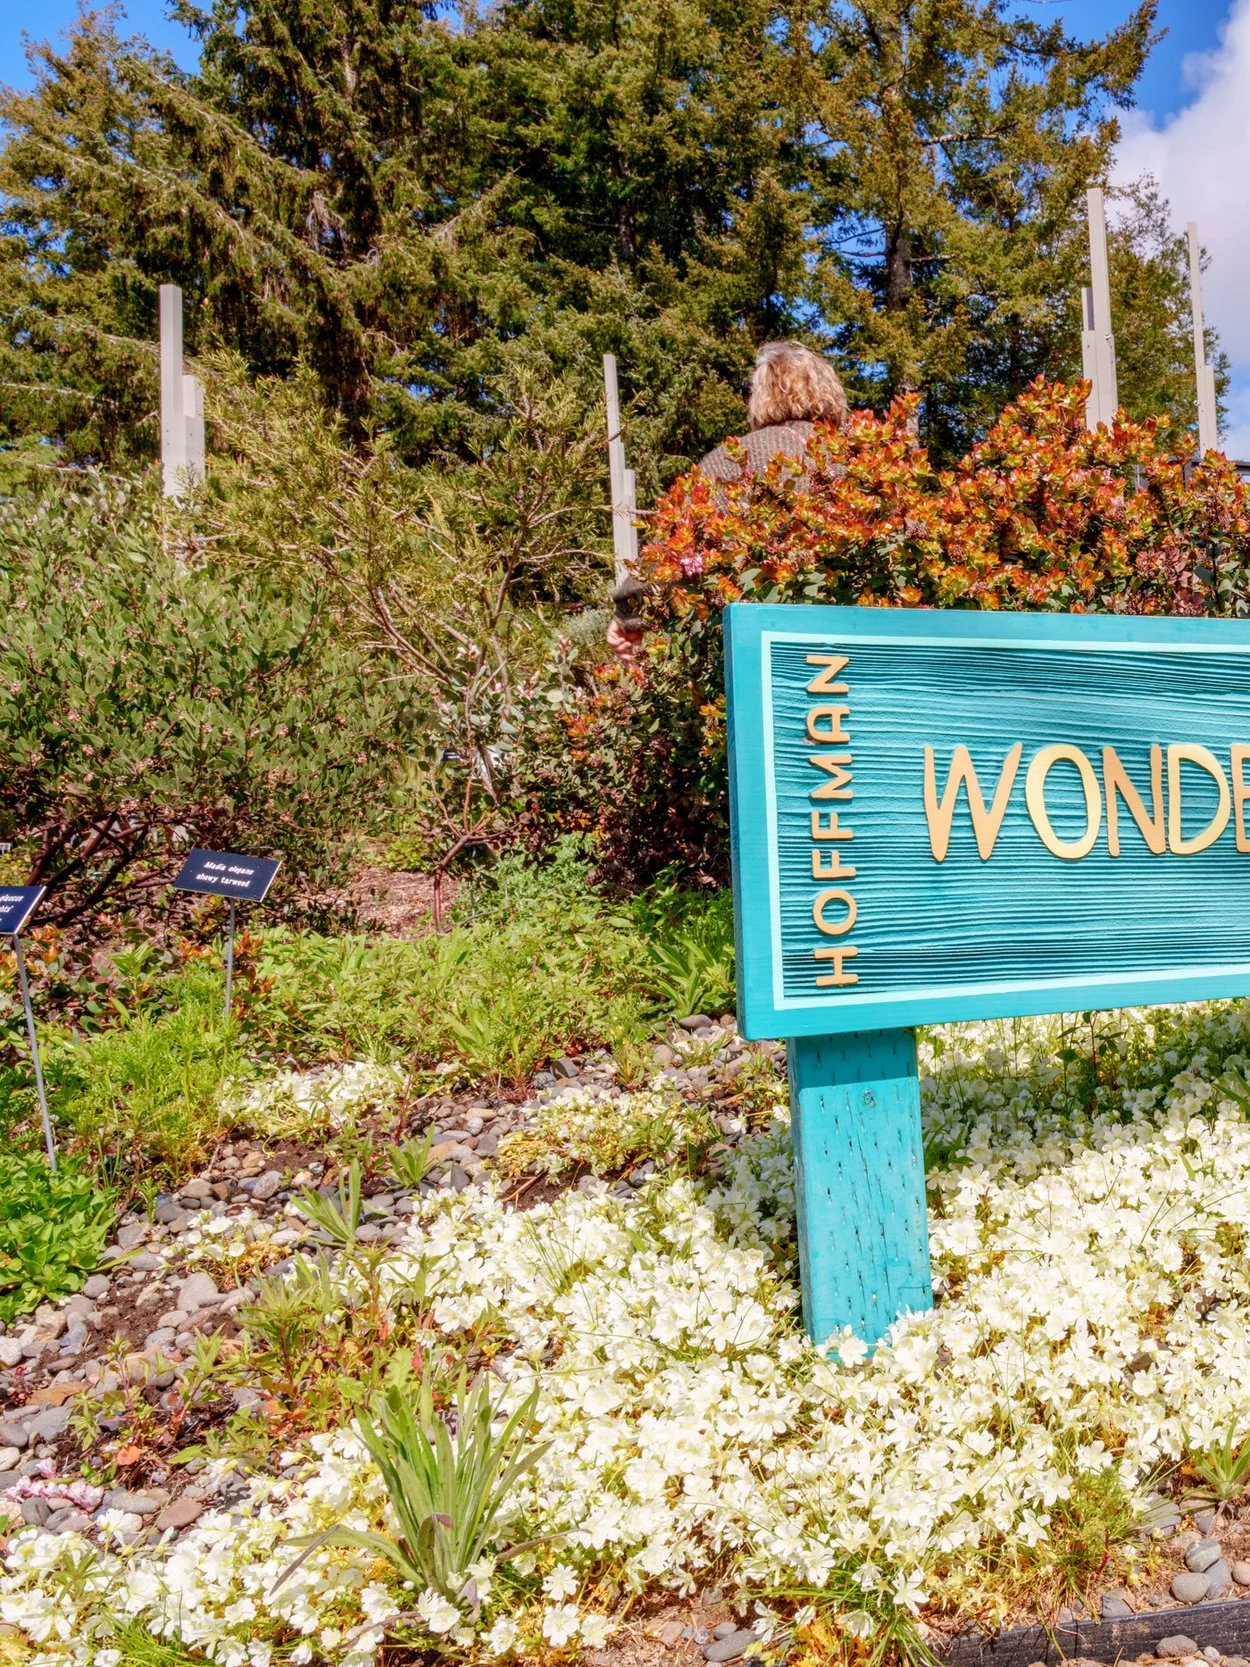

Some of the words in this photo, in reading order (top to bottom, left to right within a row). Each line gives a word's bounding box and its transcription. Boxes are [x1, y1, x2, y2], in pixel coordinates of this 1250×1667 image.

[805, 654, 859, 987] HOFFMAN
[203, 861, 226, 871] Madia
[228, 866, 254, 875] elegans
[196, 873, 219, 883] showy
[221, 877, 250, 887] tarweed
